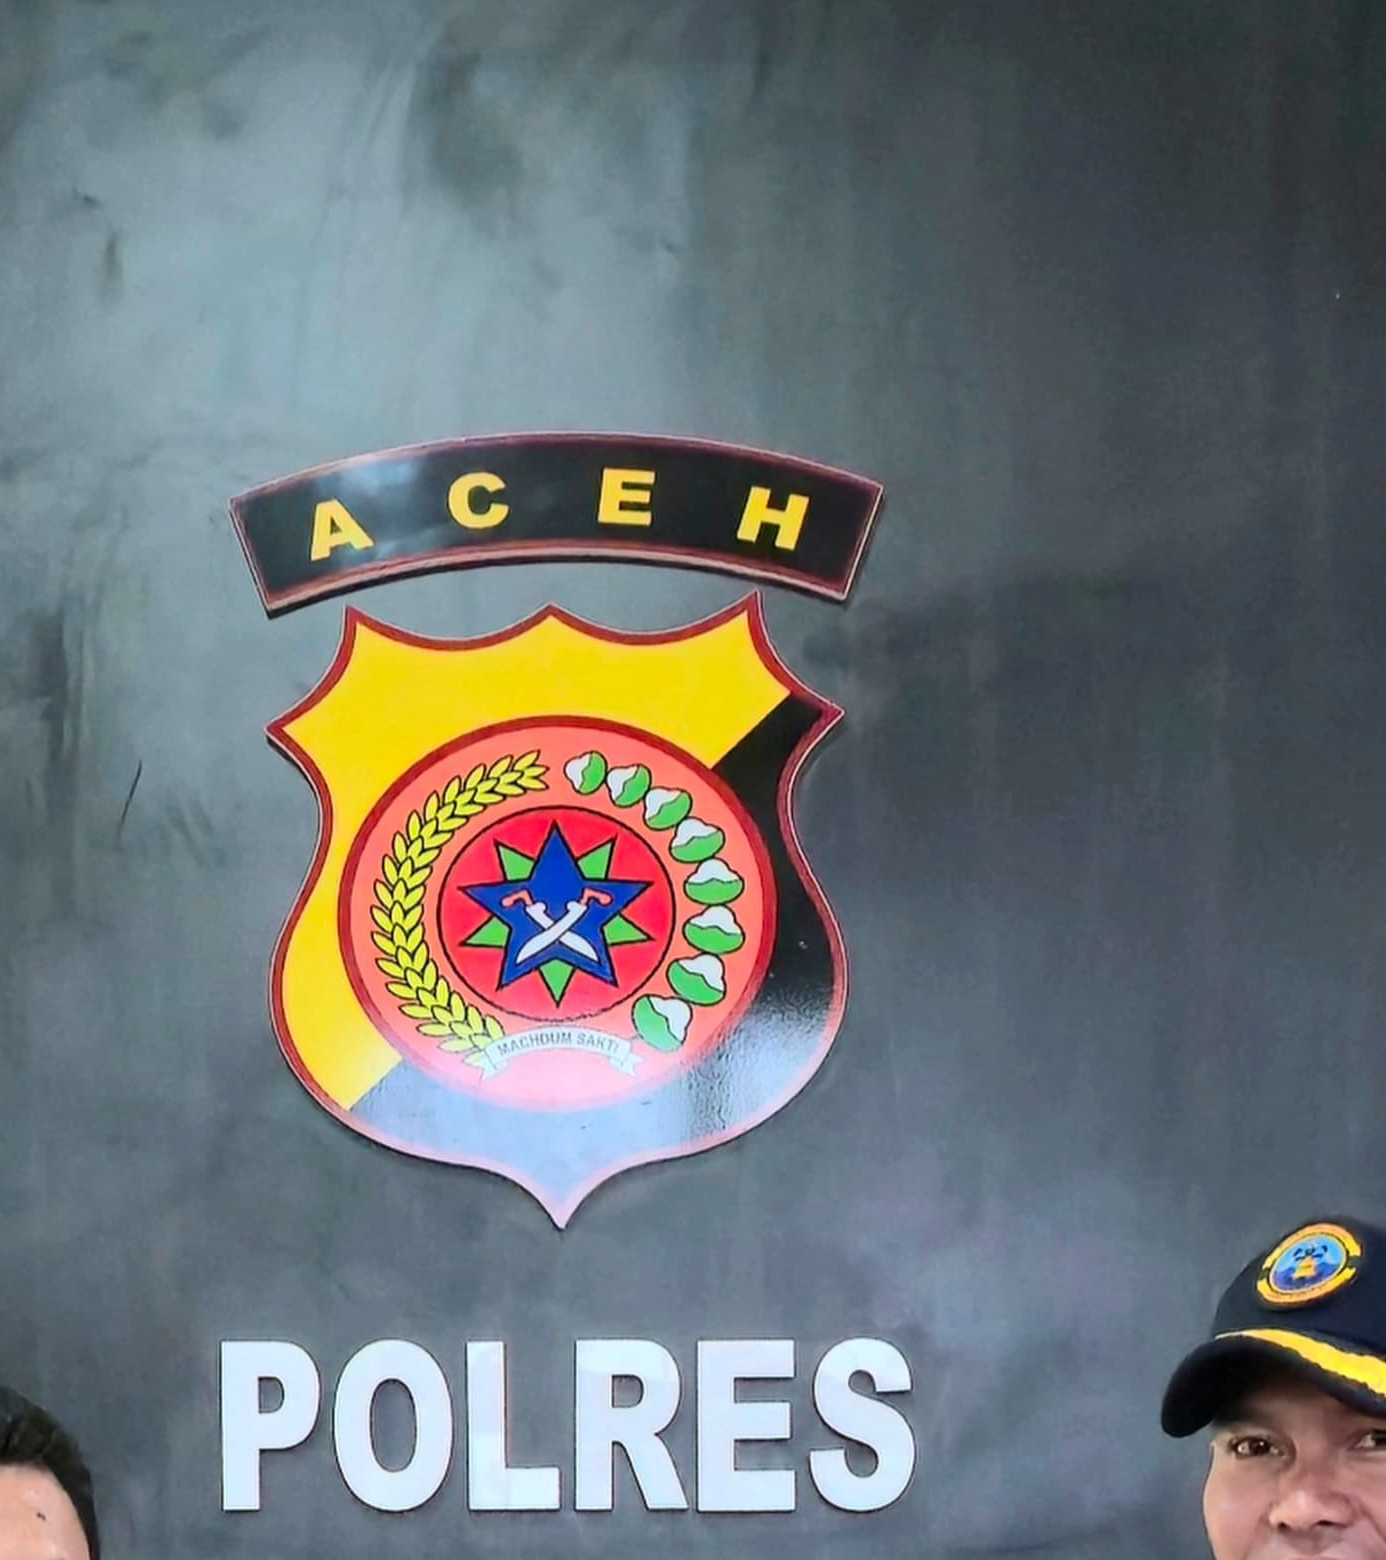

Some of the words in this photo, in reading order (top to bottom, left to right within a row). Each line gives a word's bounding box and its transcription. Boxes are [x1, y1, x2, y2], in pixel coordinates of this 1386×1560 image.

[309, 466, 811, 562] ACEH
[576, 1032, 621, 1055] SAKTI
[220, 1337, 917, 1514] POLRES
